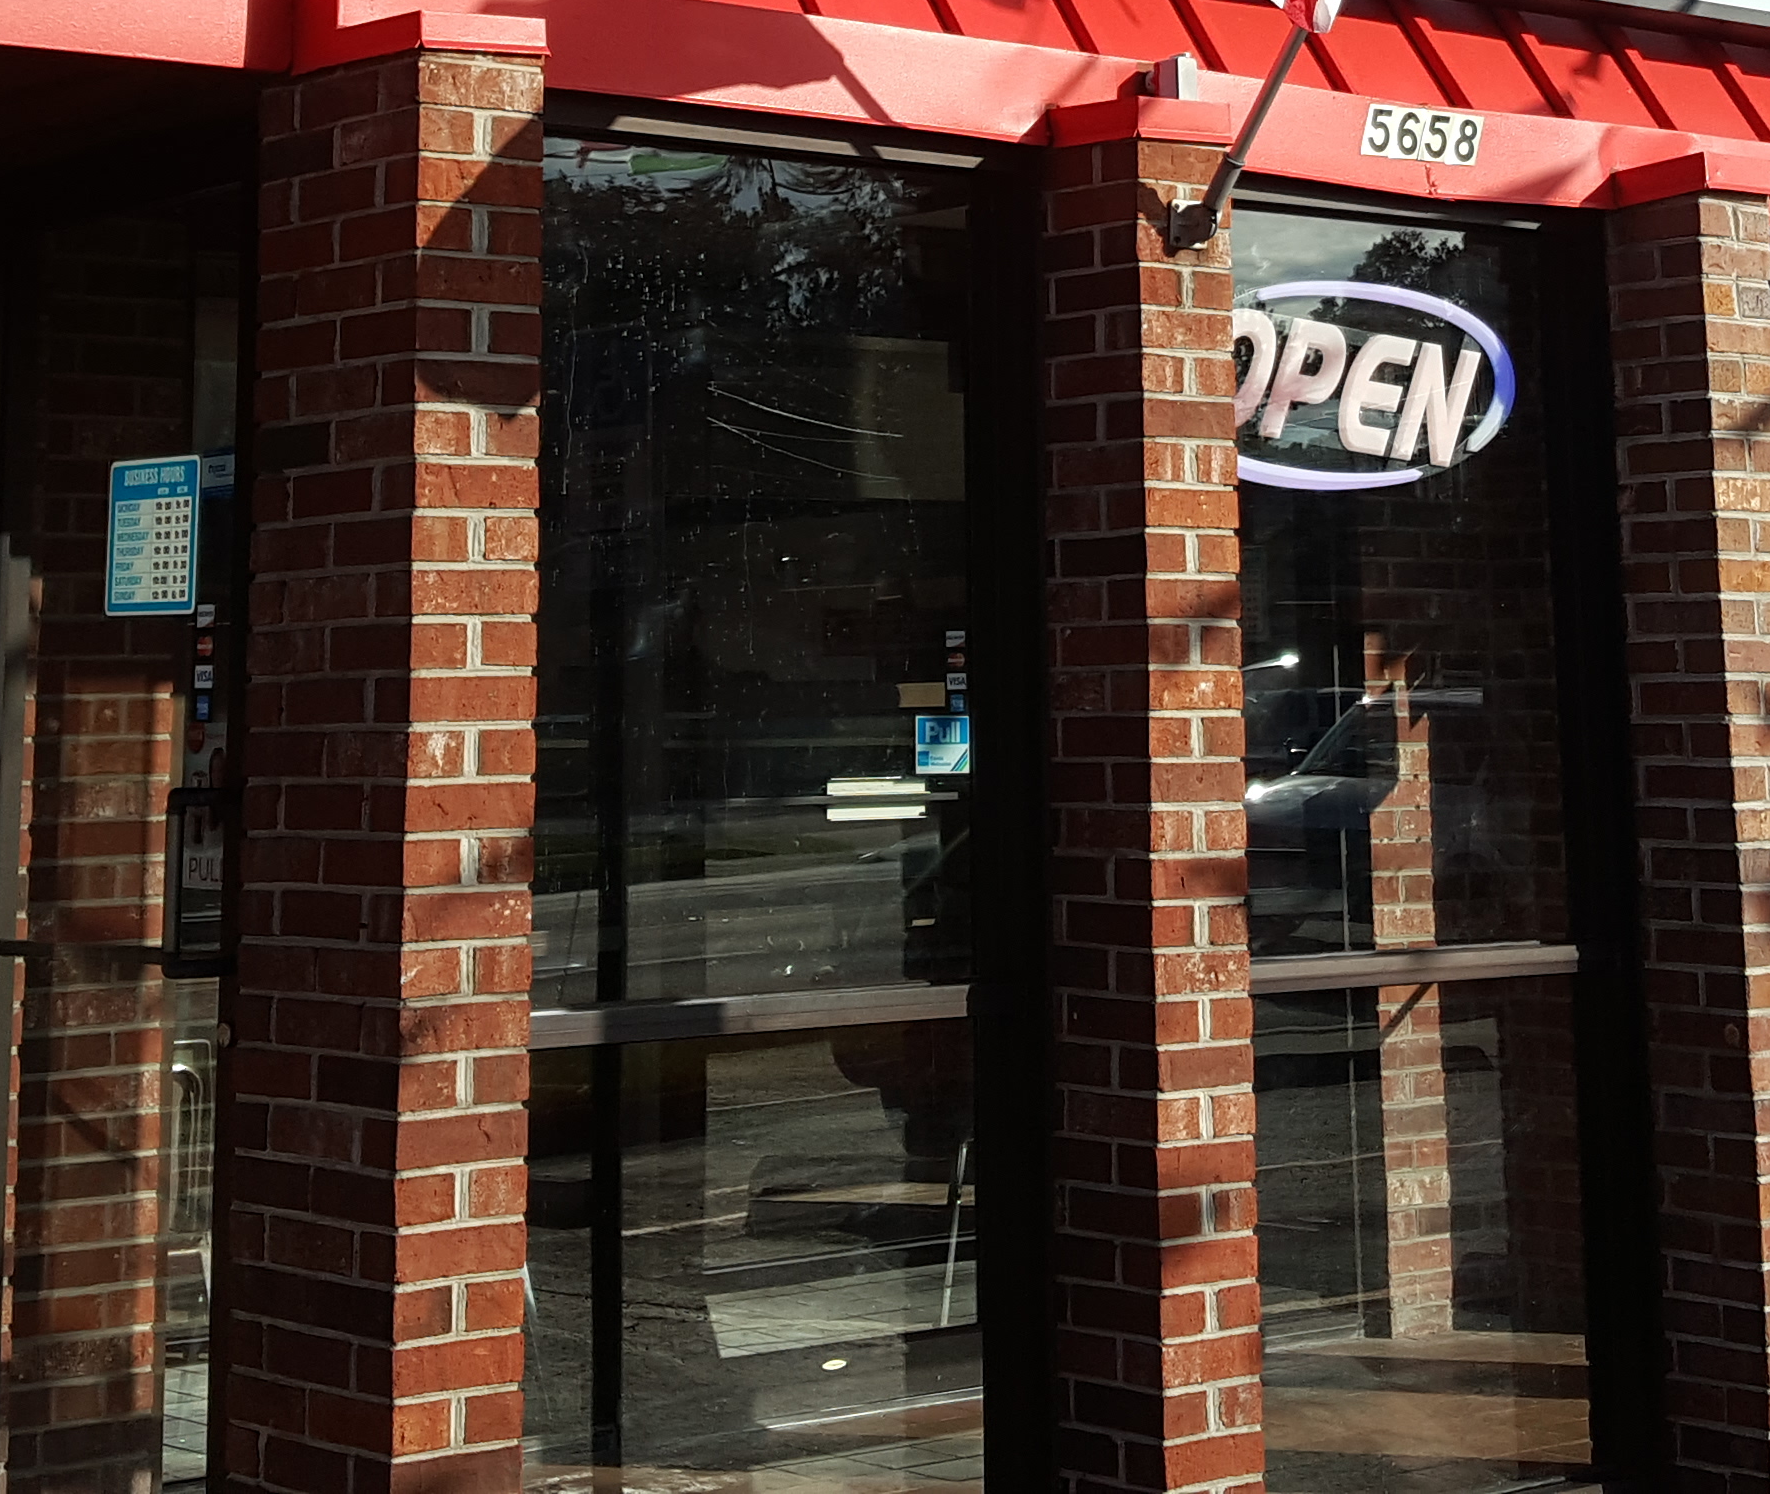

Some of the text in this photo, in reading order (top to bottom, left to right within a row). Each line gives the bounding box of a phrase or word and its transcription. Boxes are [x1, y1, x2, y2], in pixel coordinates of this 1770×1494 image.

[1368, 108, 1478, 164] 5658
[1232, 308, 1481, 468] OPEN
[124, 467, 158, 487] BUSINESS
[160, 465, 185, 484] HOURS
[196, 669, 213, 683] VISA
[948, 675, 967, 686] VISA
[925, 721, 961, 743] Pull
